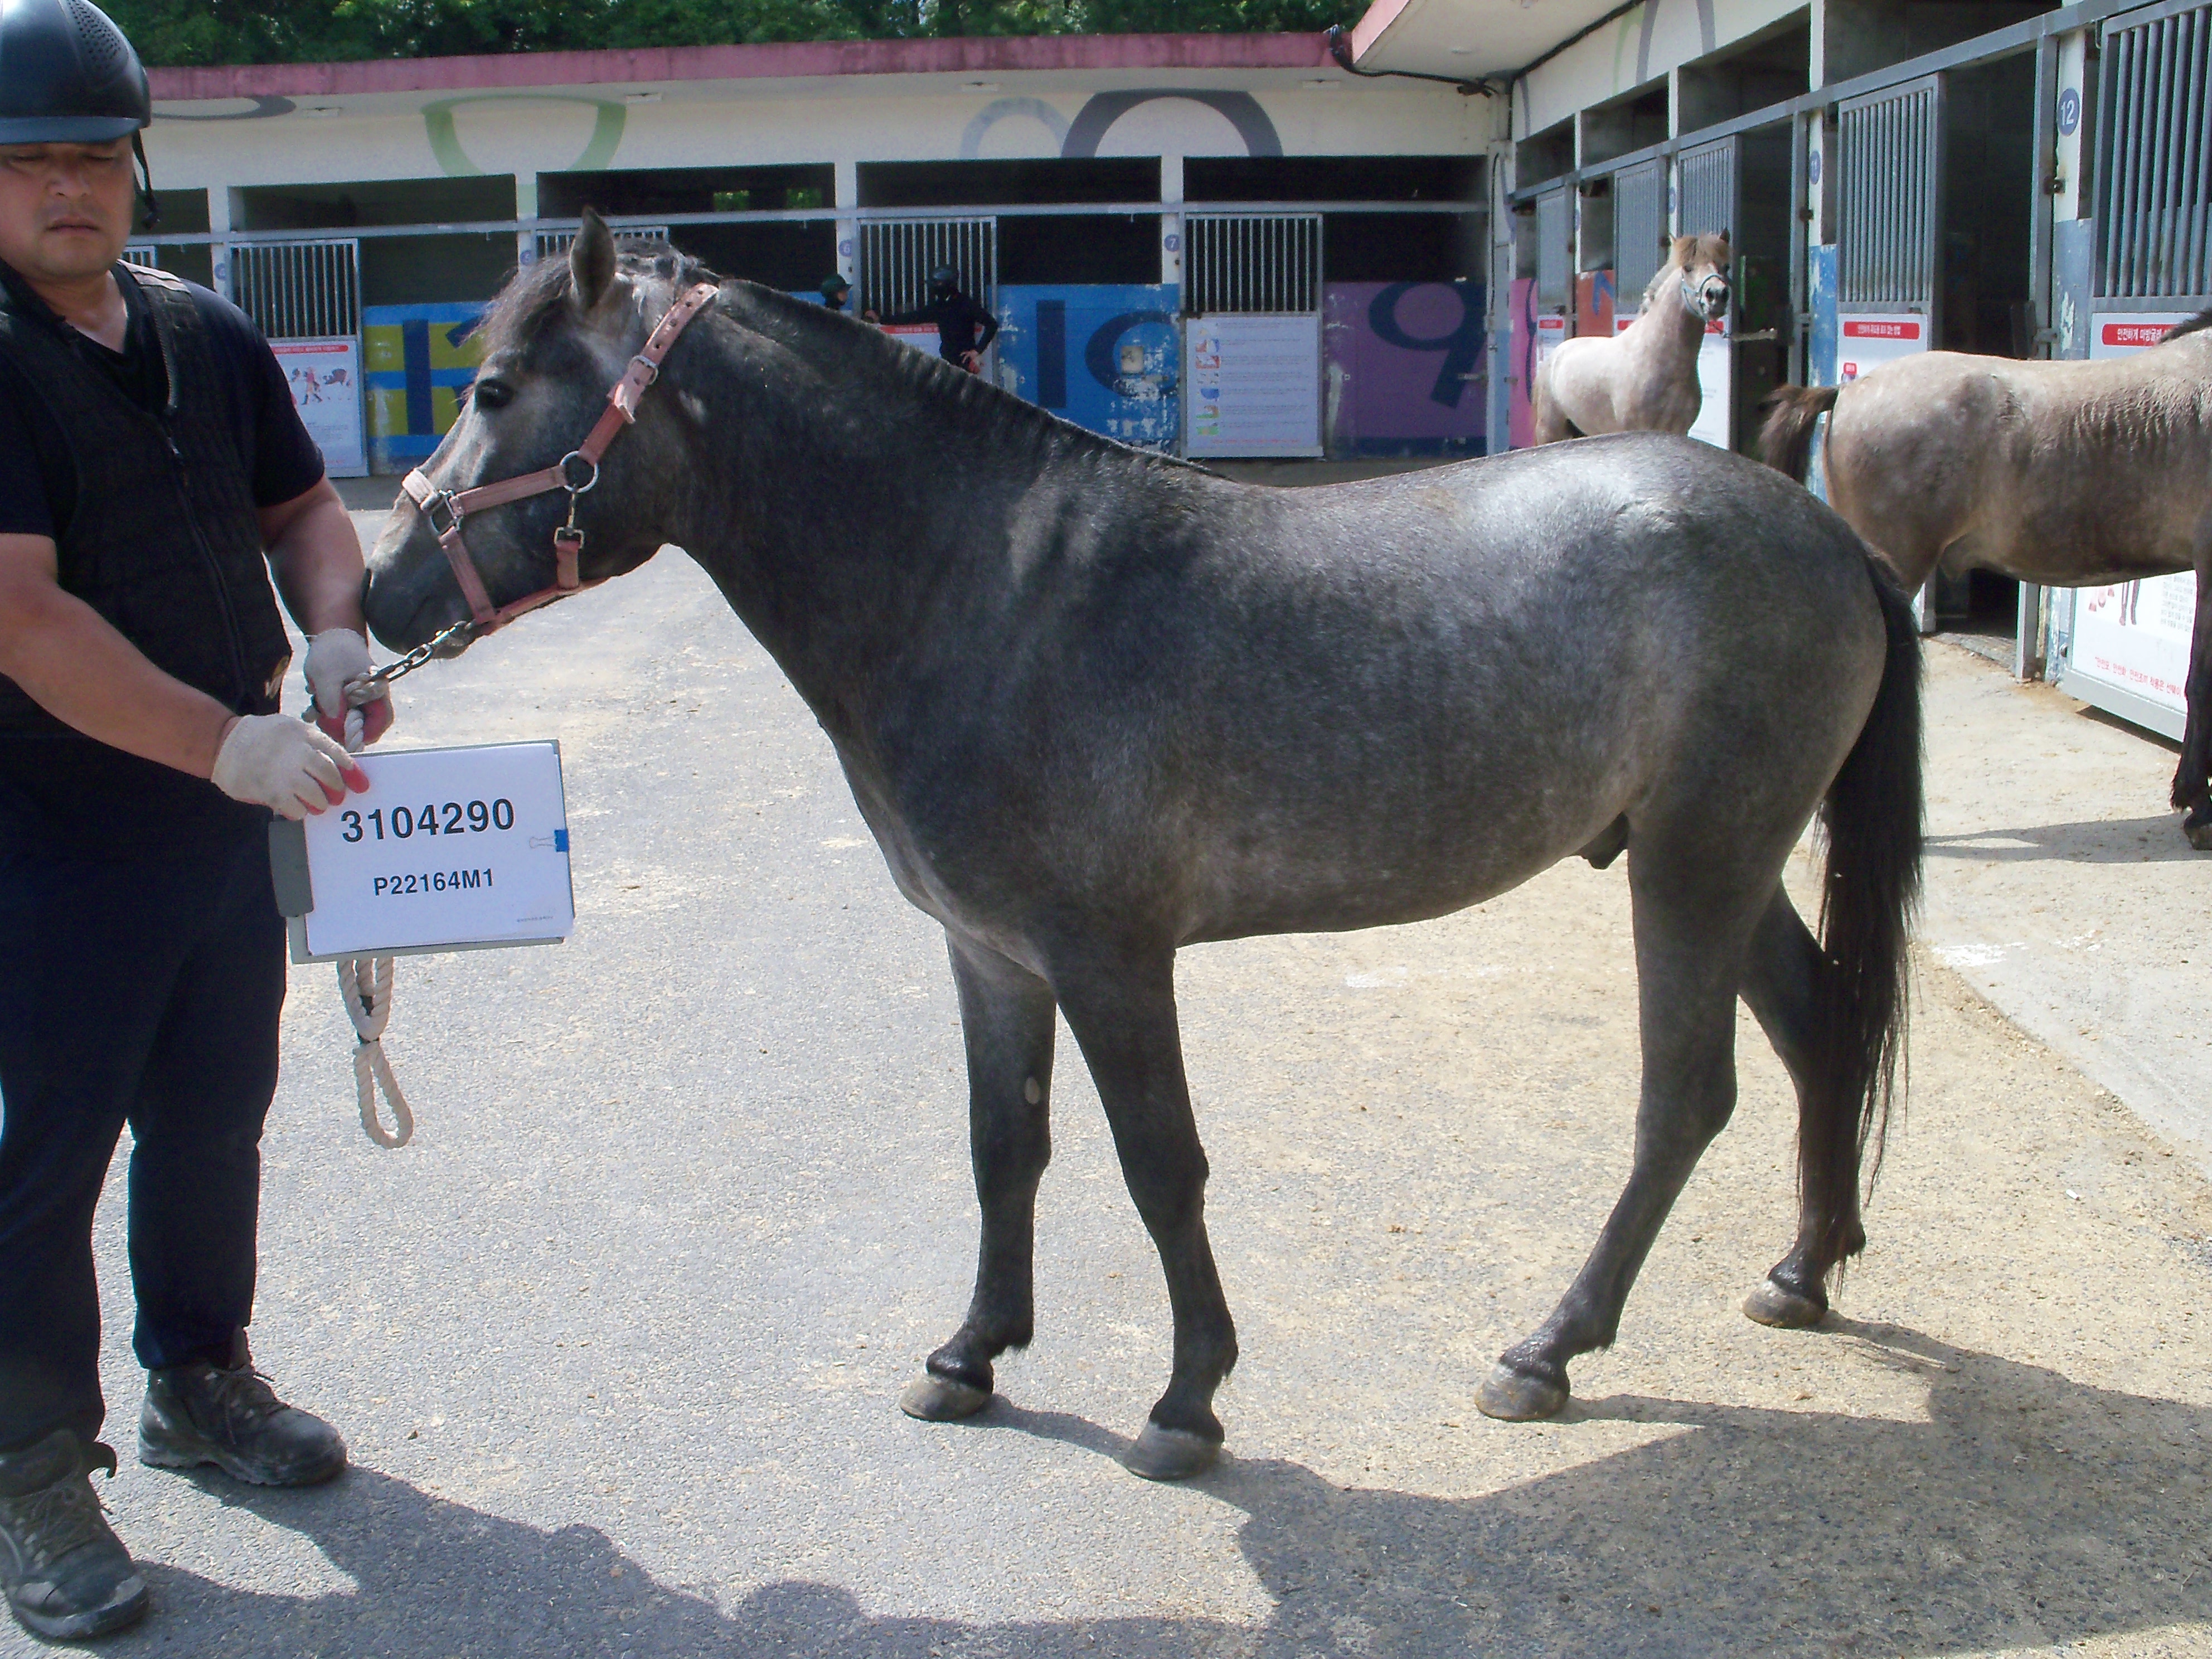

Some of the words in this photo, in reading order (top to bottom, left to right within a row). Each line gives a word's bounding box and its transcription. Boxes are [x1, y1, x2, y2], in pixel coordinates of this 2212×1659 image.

[2060, 99, 2075, 126] 12
[1170, 237, 1176, 249] 7
[2117, 328, 2139, 341] 안전하게
[341, 798, 515, 843] 3104290
[373, 867, 495, 897] P22164M1
